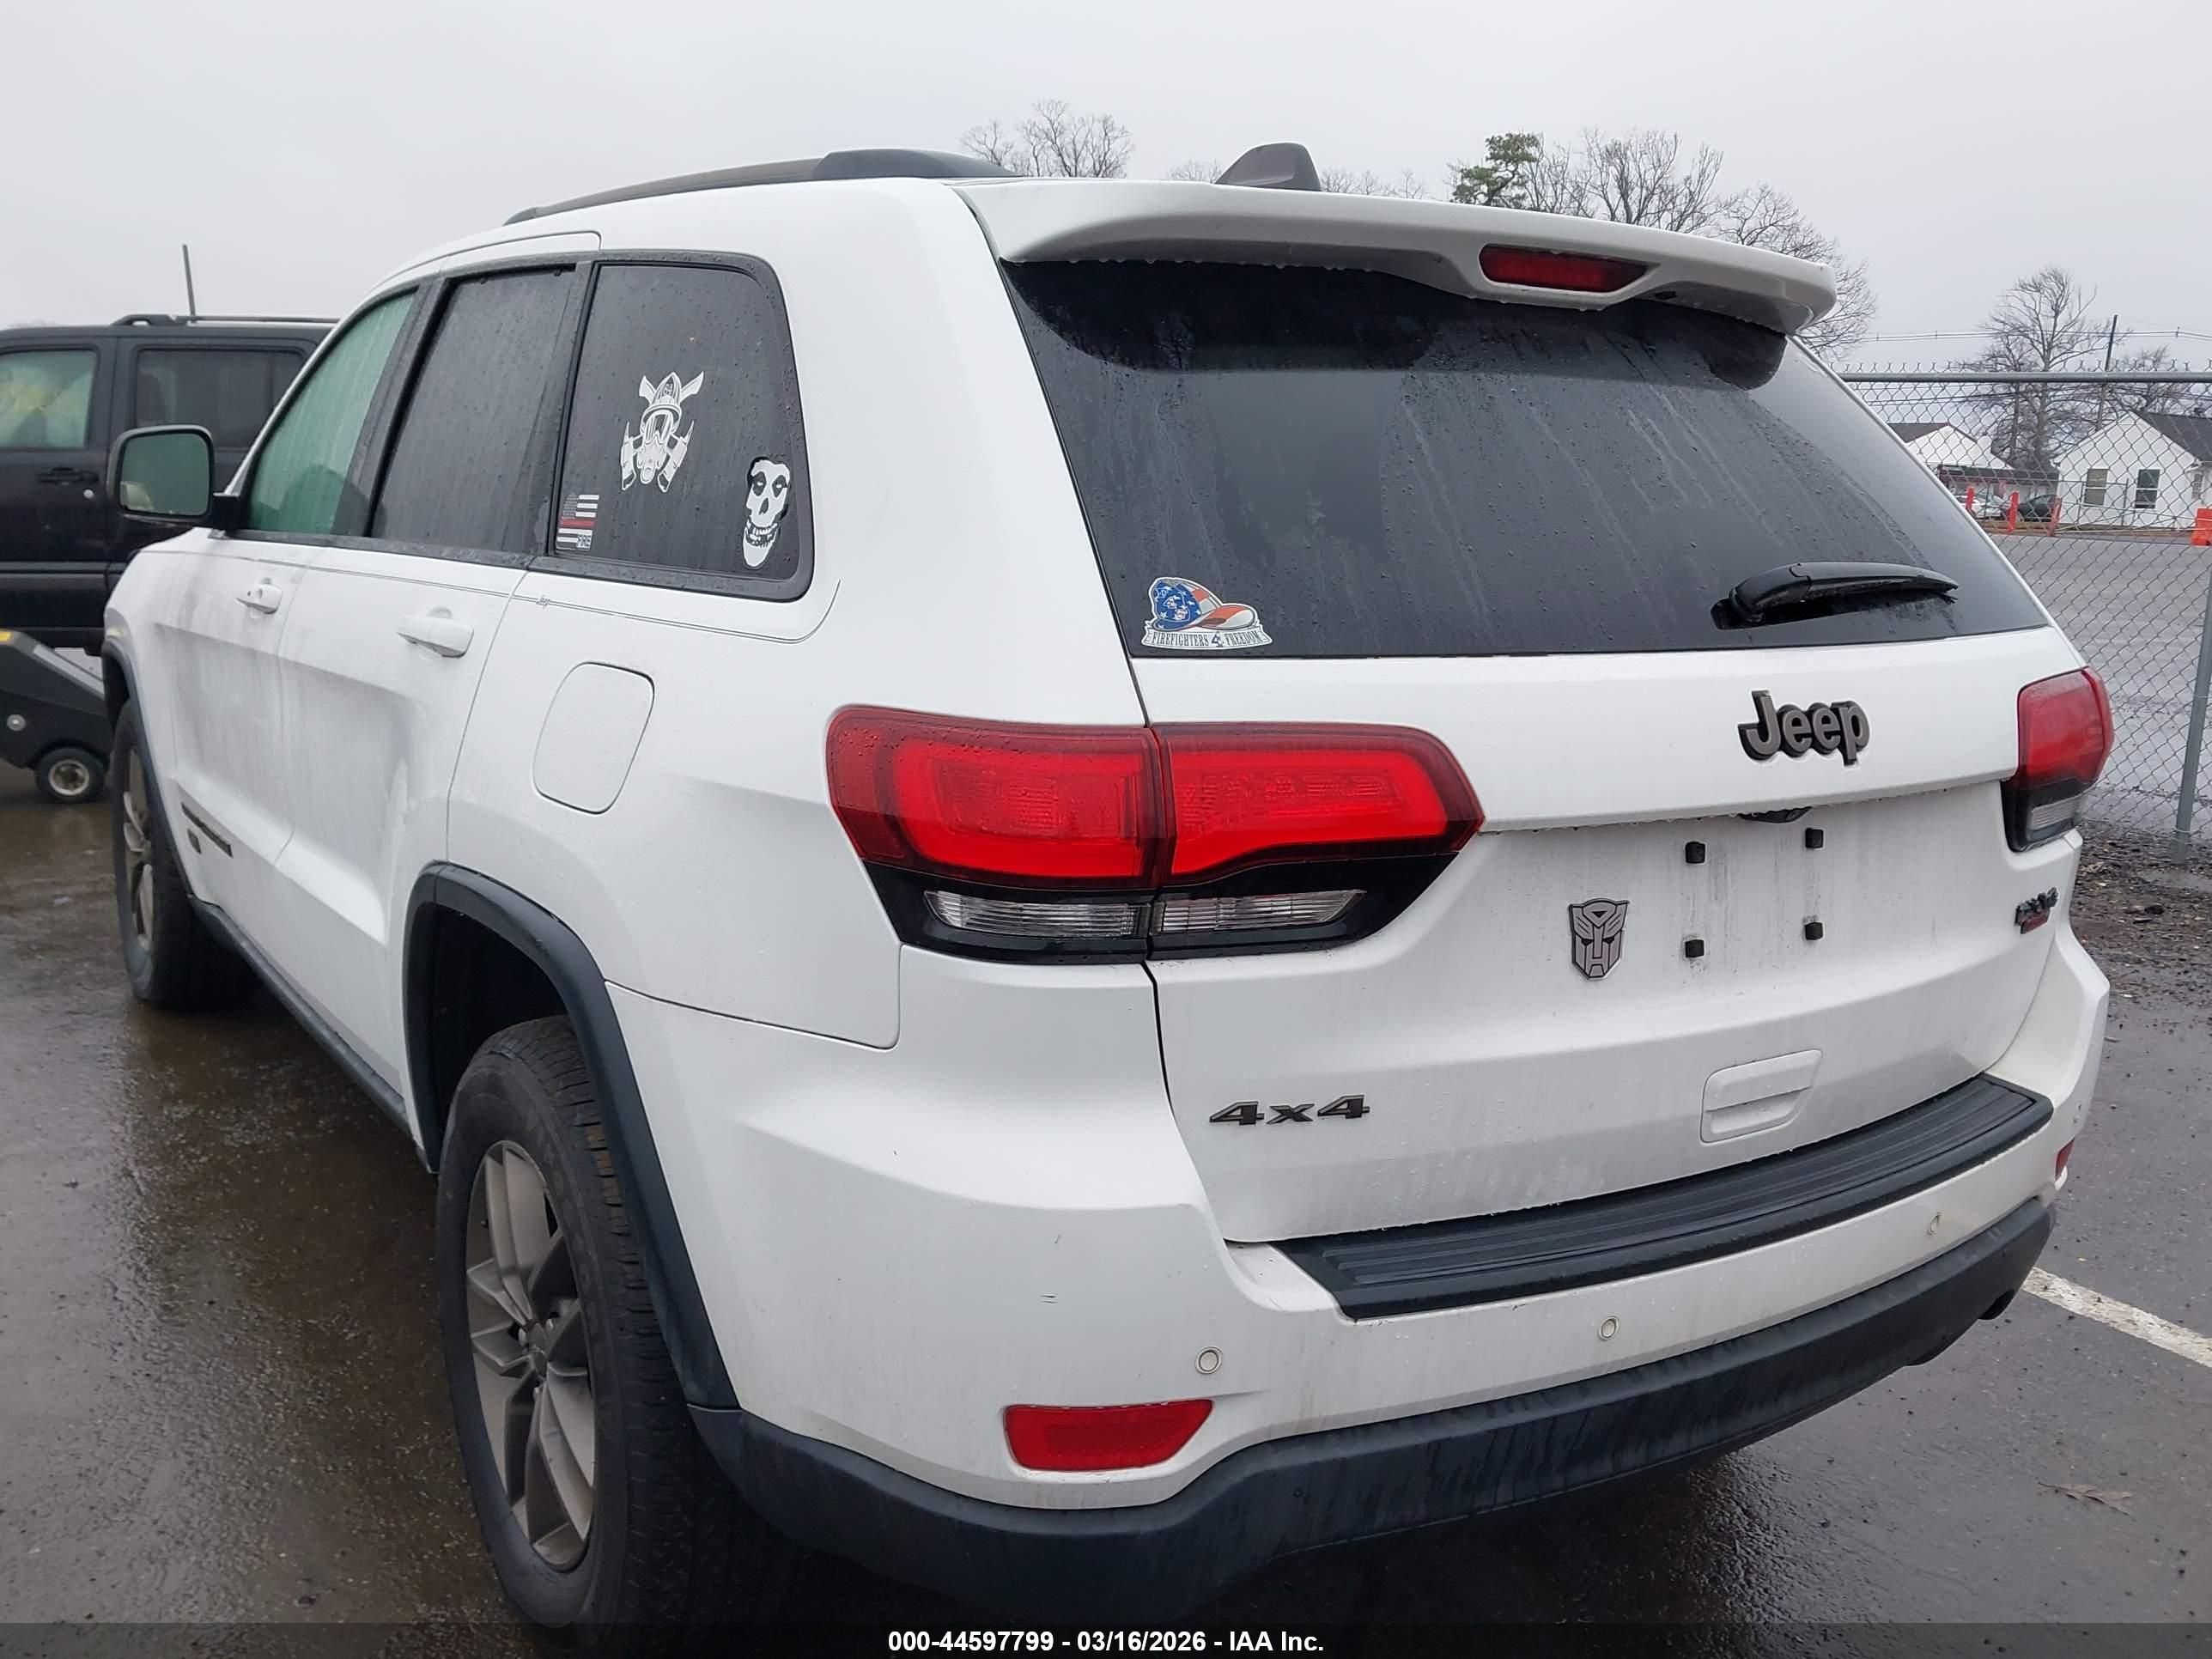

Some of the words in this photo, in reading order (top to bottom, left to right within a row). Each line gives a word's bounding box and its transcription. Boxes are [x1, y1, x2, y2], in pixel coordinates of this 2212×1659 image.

[576, 535, 592, 547] FIRE
[1152, 631, 1209, 647] FIREFIGHTERS
[1225, 630, 1262, 646] FREEDOM
[1737, 690, 1870, 766] Jeep
[1209, 1094, 1370, 1126] 4x4
